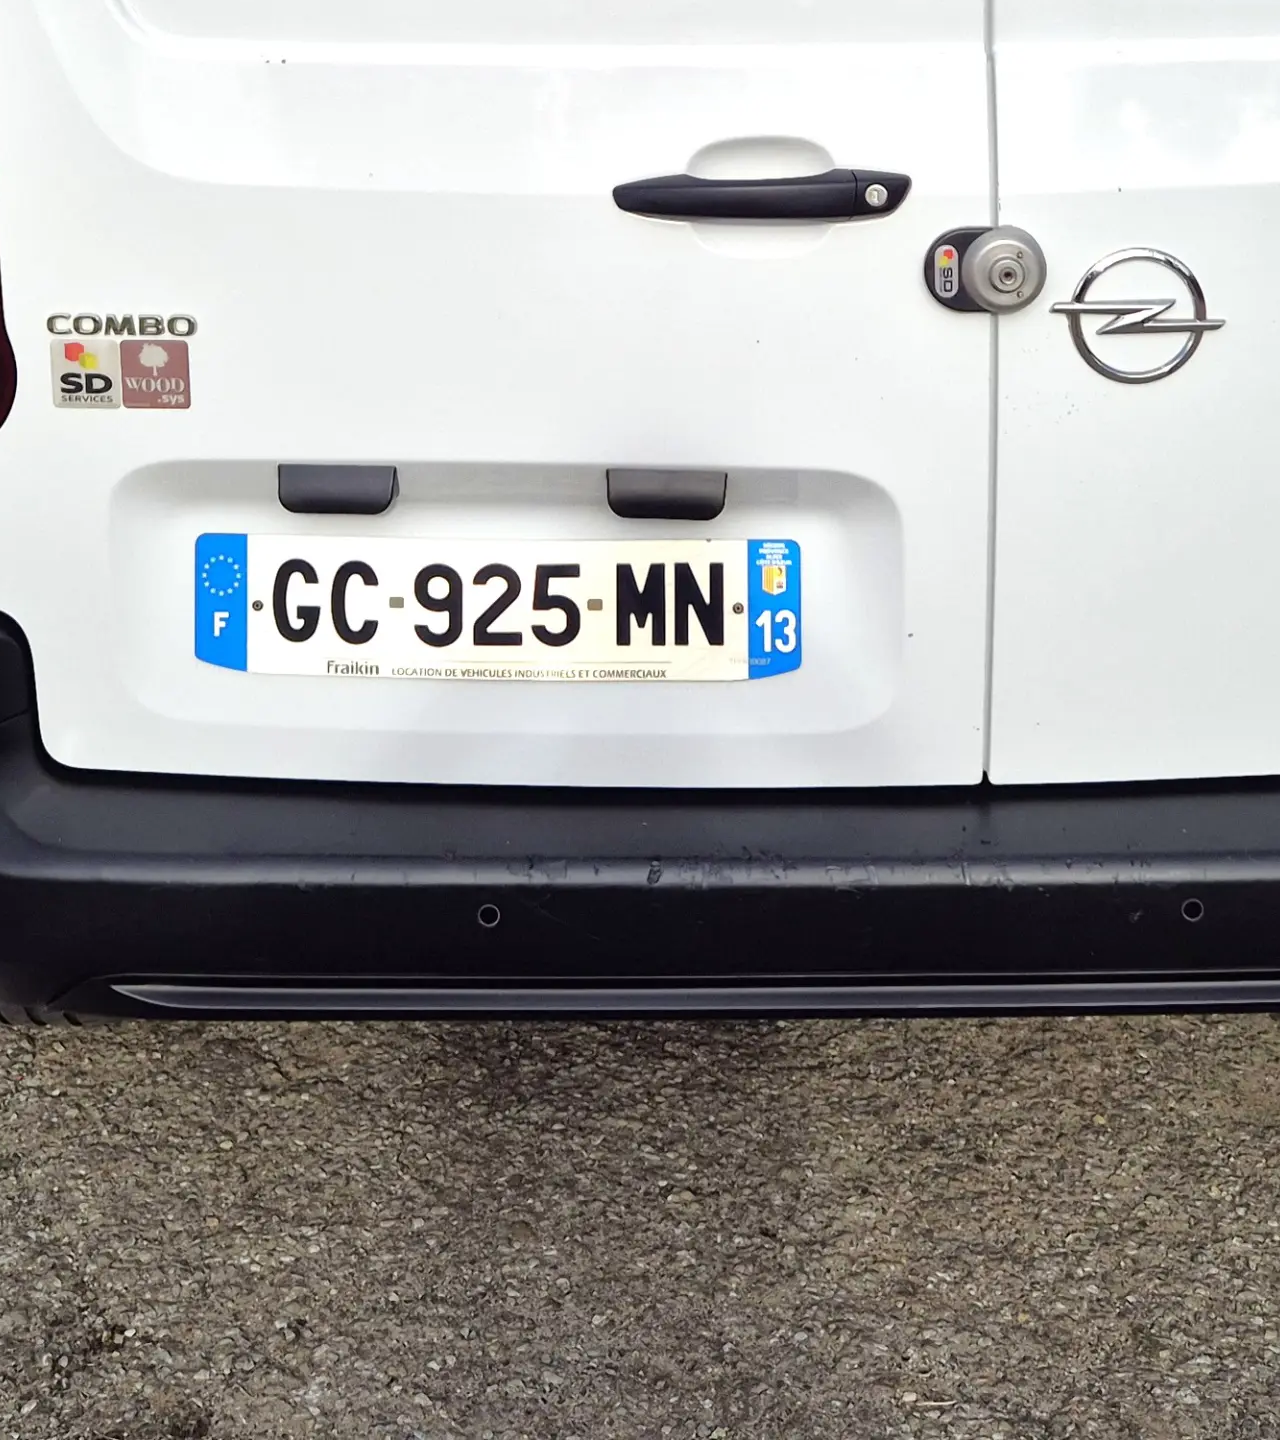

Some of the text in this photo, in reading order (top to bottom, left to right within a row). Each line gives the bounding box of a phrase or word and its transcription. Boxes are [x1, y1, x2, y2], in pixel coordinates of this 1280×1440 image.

[942, 267, 953, 292] SD
[46, 313, 198, 337] COMBO
[60, 372, 113, 394] SD
[124, 376, 185, 393] WOOD
[61, 395, 114, 403] SERVICES
[213, 610, 229, 638] F
[755, 609, 797, 653] 13
[326, 660, 380, 676] Fraikin
[391, 667, 442, 677] LOCATION
[444, 668, 458, 677] DE
[578, 669, 590, 679] ET
[592, 669, 667, 679] COMMERCIAUX
